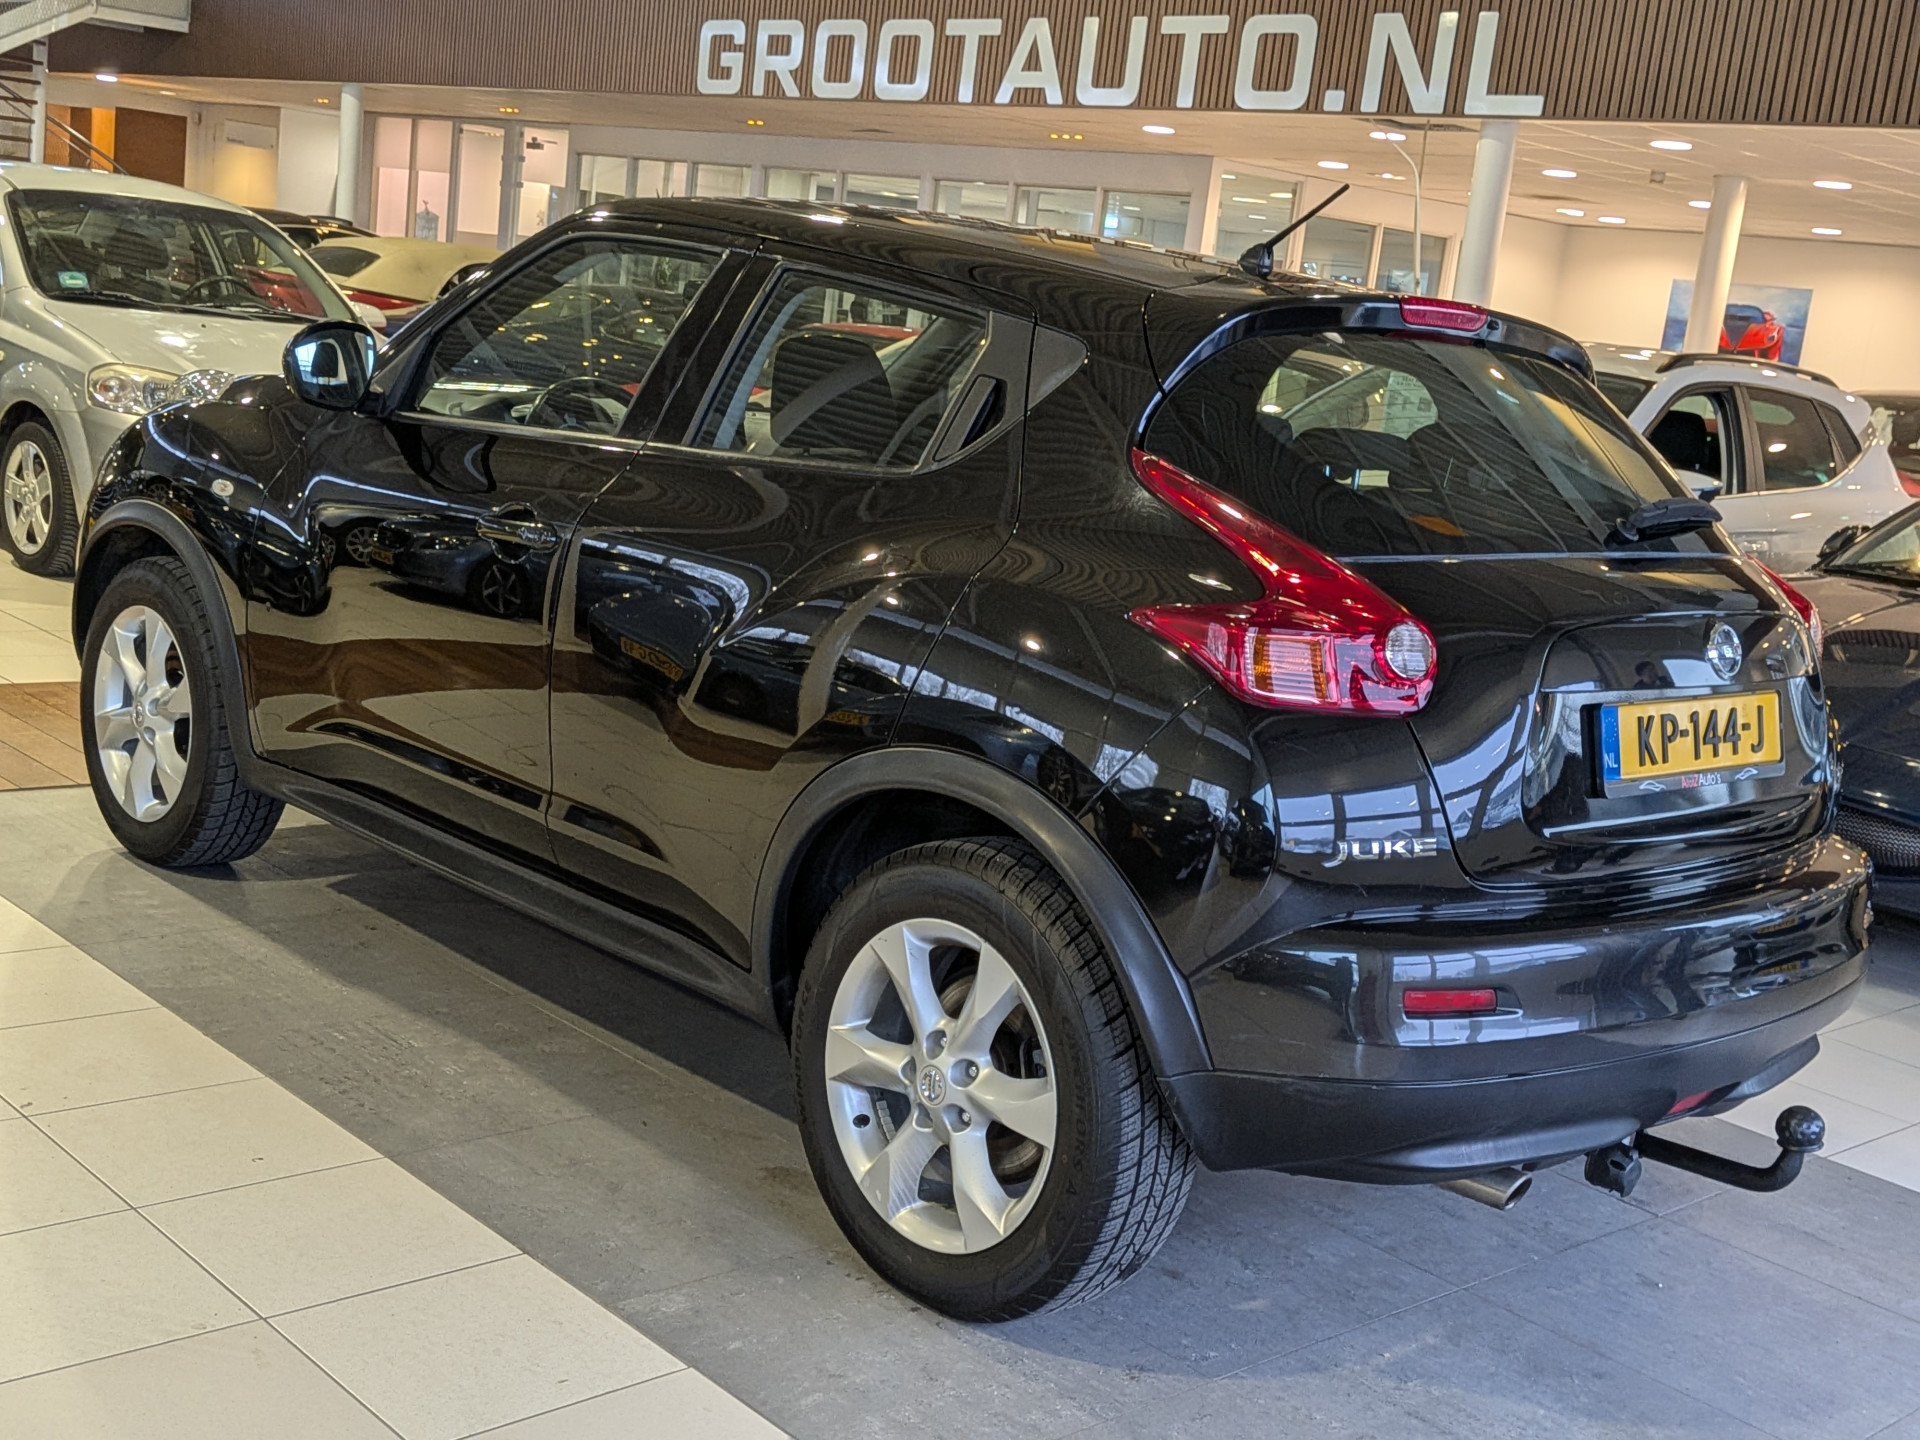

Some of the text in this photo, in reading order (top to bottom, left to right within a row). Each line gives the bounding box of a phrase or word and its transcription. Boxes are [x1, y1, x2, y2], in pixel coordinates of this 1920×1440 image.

[697, 11, 1545, 117] GROOTAUTO.NL
[1637, 705, 1765, 767] KP-144-J
[1605, 752, 1618, 768] NL
[1321, 838, 1438, 868] JUKE
